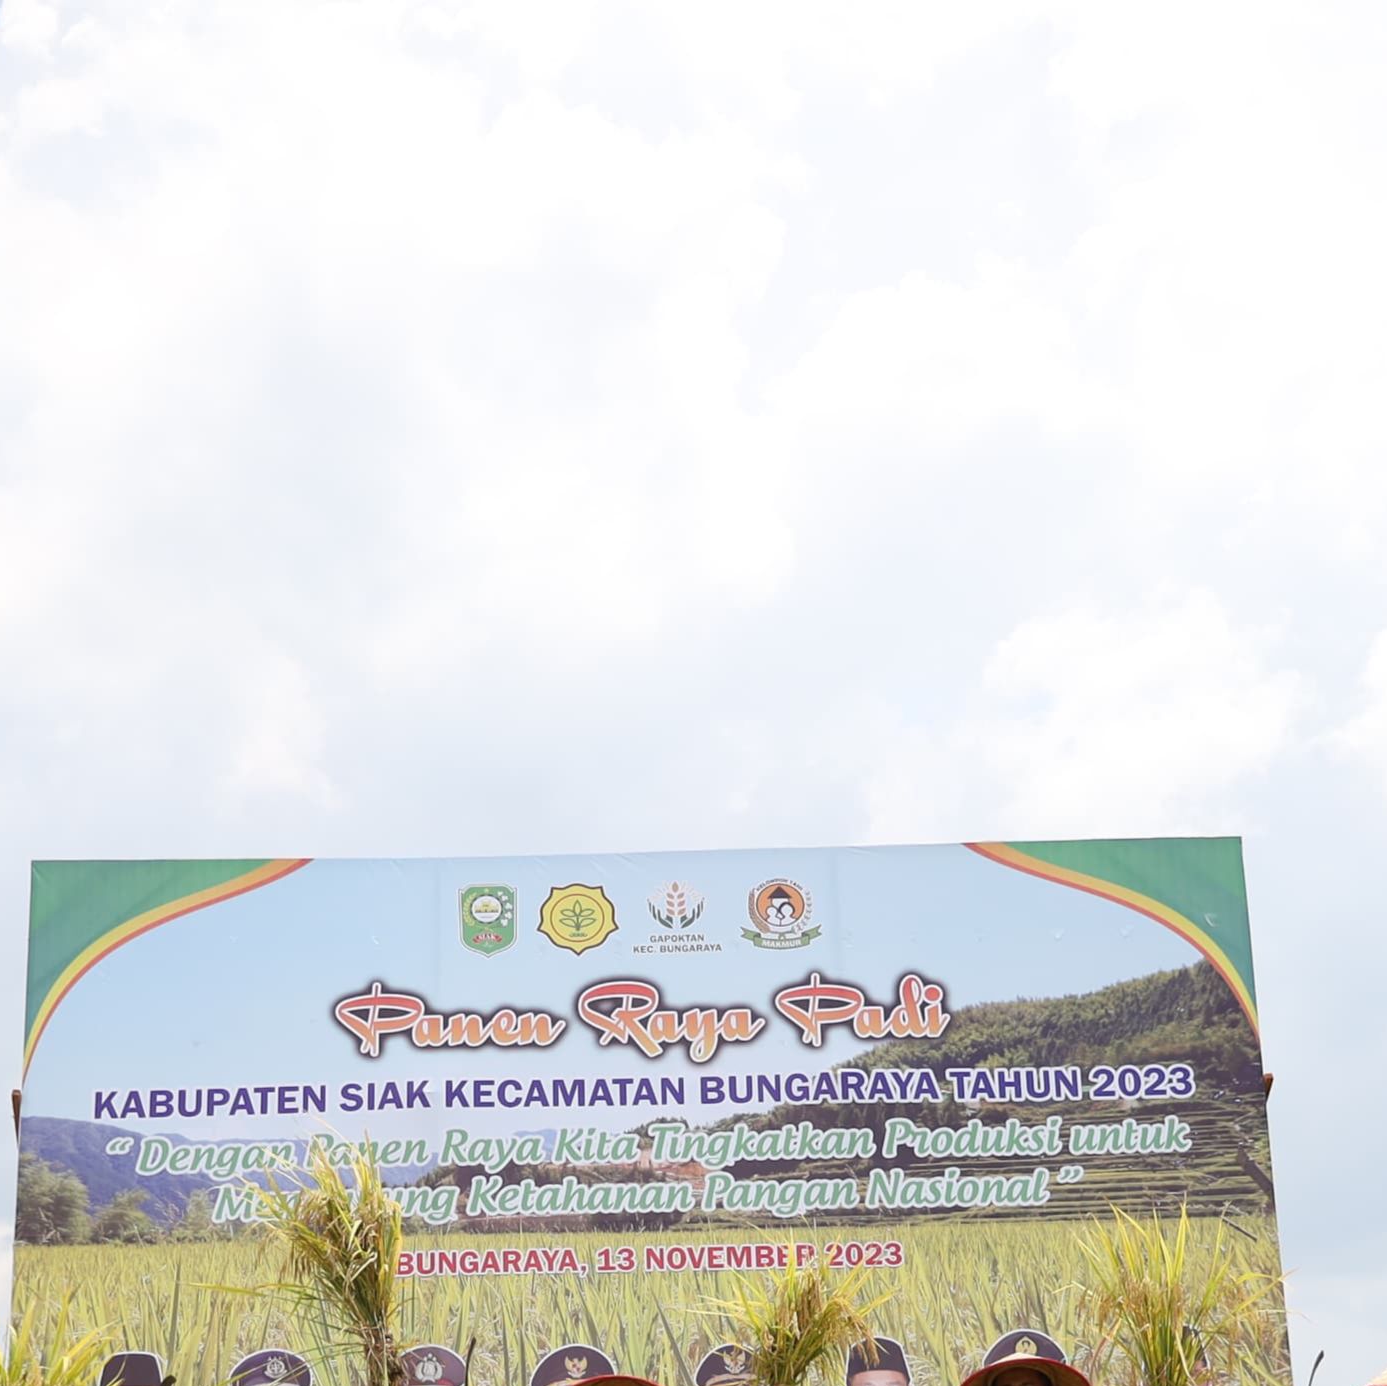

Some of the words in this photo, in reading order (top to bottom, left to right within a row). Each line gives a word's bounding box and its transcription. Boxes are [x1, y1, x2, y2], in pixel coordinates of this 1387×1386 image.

[633, 945, 657, 955] KEC.
[659, 943, 722, 954] BUNGARAYA
[649, 933, 705, 944] GAPOKTAN
[762, 939, 802, 949] MAKMUR
[335, 981, 567, 1059] Panen
[577, 979, 766, 1064] Raya
[775, 972, 950, 1047] Padi
[93, 1085, 327, 1120] KABUPATEN
[339, 1080, 431, 1112] SIAK
[444, 1076, 686, 1109] KECAMATAN
[699, 1070, 940, 1105] BUNGARAYA
[949, 1068, 1081, 1100] TAHUN
[1090, 1066, 1194, 1098] 2023
[441, 1128, 542, 1172] Raya
[555, 1125, 636, 1163] Kita
[651, 1122, 874, 1165] Tingkatkan
[885, 1118, 1063, 1158] Produksi
[1072, 1117, 1189, 1154] untuk
[468, 1175, 693, 1217] Ketahanan
[703, 1172, 857, 1217] Pangan
[396, 1247, 588, 1277] BUNGARAYA,
[597, 1246, 636, 1272] 13
[645, 1244, 814, 1273] NOVEMBER
[824, 1241, 904, 1268] 2023
